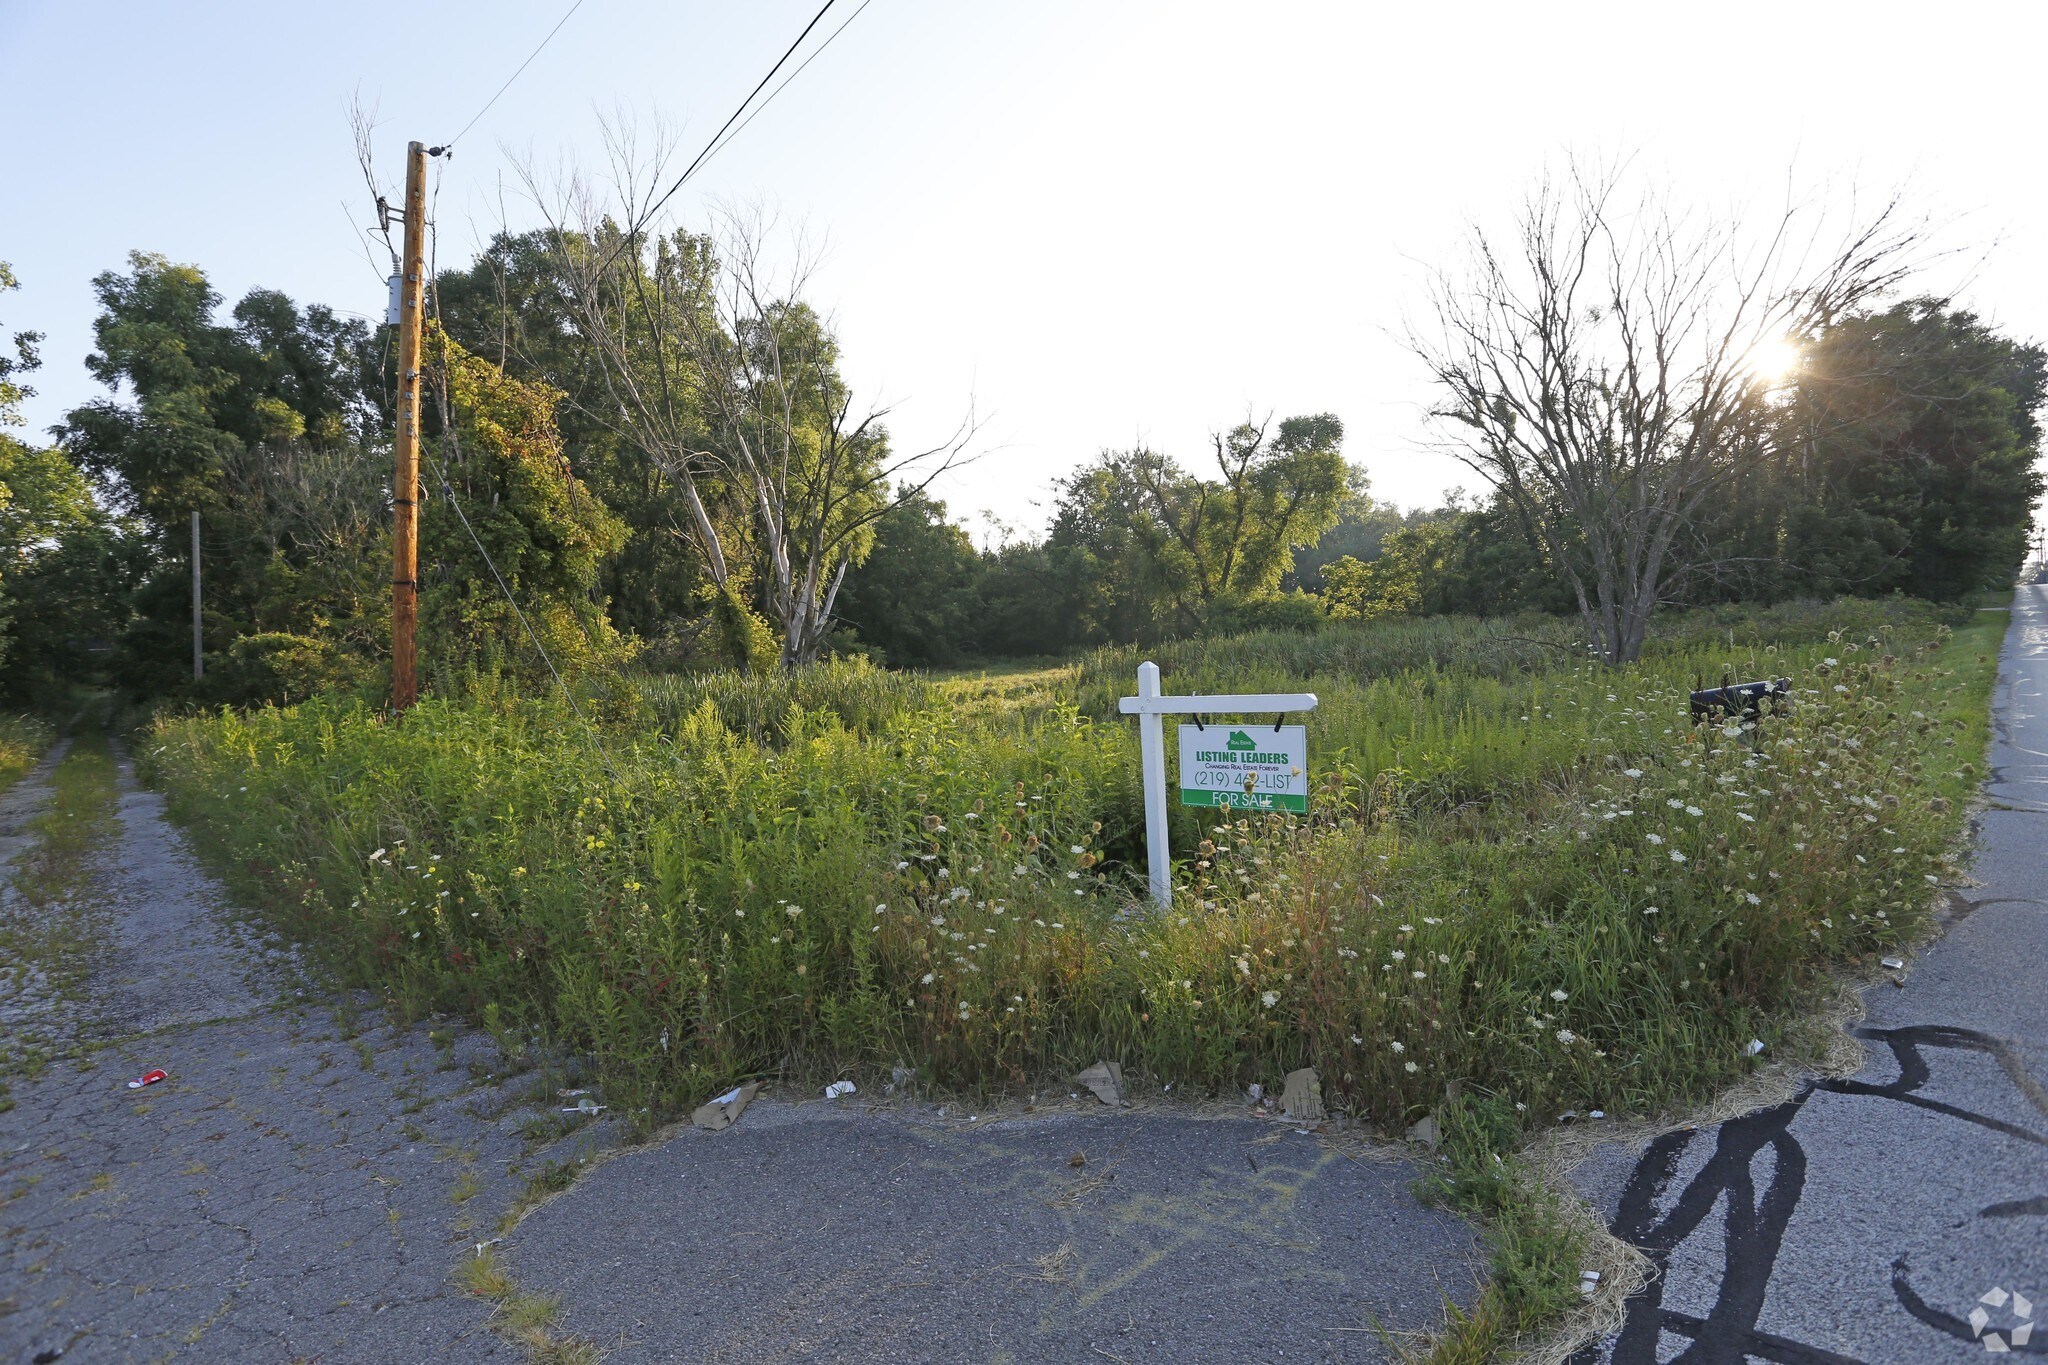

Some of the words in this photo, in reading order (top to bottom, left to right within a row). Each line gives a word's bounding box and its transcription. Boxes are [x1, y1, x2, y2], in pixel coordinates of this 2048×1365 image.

[1196, 751, 1237, 763] LISTING
[1241, 752, 1289, 765] LEADERS
[1194, 771, 1230, 788] (219)
[1212, 791, 1239, 806] FOR
[1241, 793, 1273, 808] SALE
